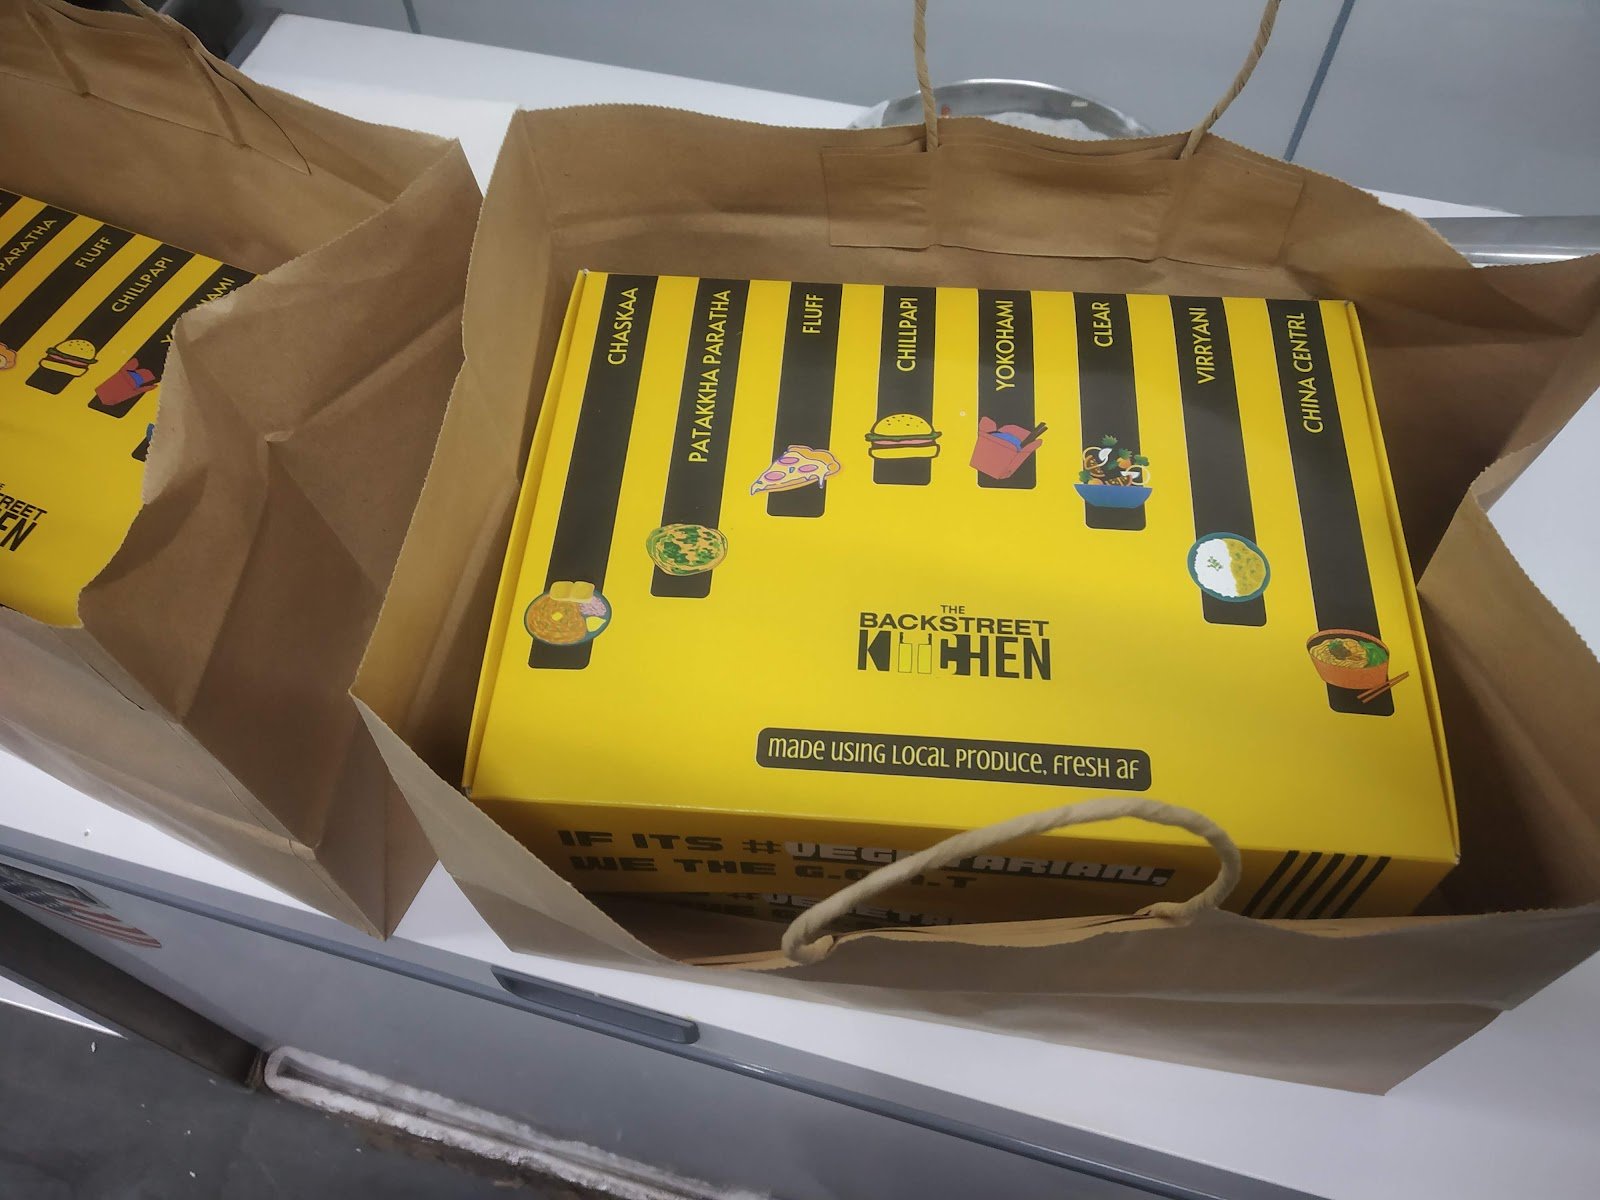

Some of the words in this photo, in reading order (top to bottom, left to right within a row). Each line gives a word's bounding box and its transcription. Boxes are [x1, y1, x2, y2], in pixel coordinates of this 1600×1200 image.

[75, 236, 112, 269] FLUFF
[111, 256, 174, 313] CHILLPAPI
[607, 287, 639, 365] CHASKAA
[702, 289, 732, 366] PARATHA
[802, 293, 824, 335] FLUFF
[896, 297, 918, 372] CHILLPAPI
[1093, 301, 1114, 348] CLEAR
[995, 300, 1016, 392] YOKOHAMI
[1189, 307, 1217, 384] VIRRYANI
[1286, 313, 1314, 373] CENTRL
[688, 368, 720, 463] PATAKKHA
[1299, 377, 1324, 433] CHINA
[859, 612, 1050, 637] BACKSTREET
[940, 604, 966, 615] THE
[857, 629, 1052, 681] KITCHEN
[558, 830, 613, 847] IF
[632, 832, 724, 851] ITS
[569, 856, 658, 872] WE
[673, 858, 777, 876] THE
